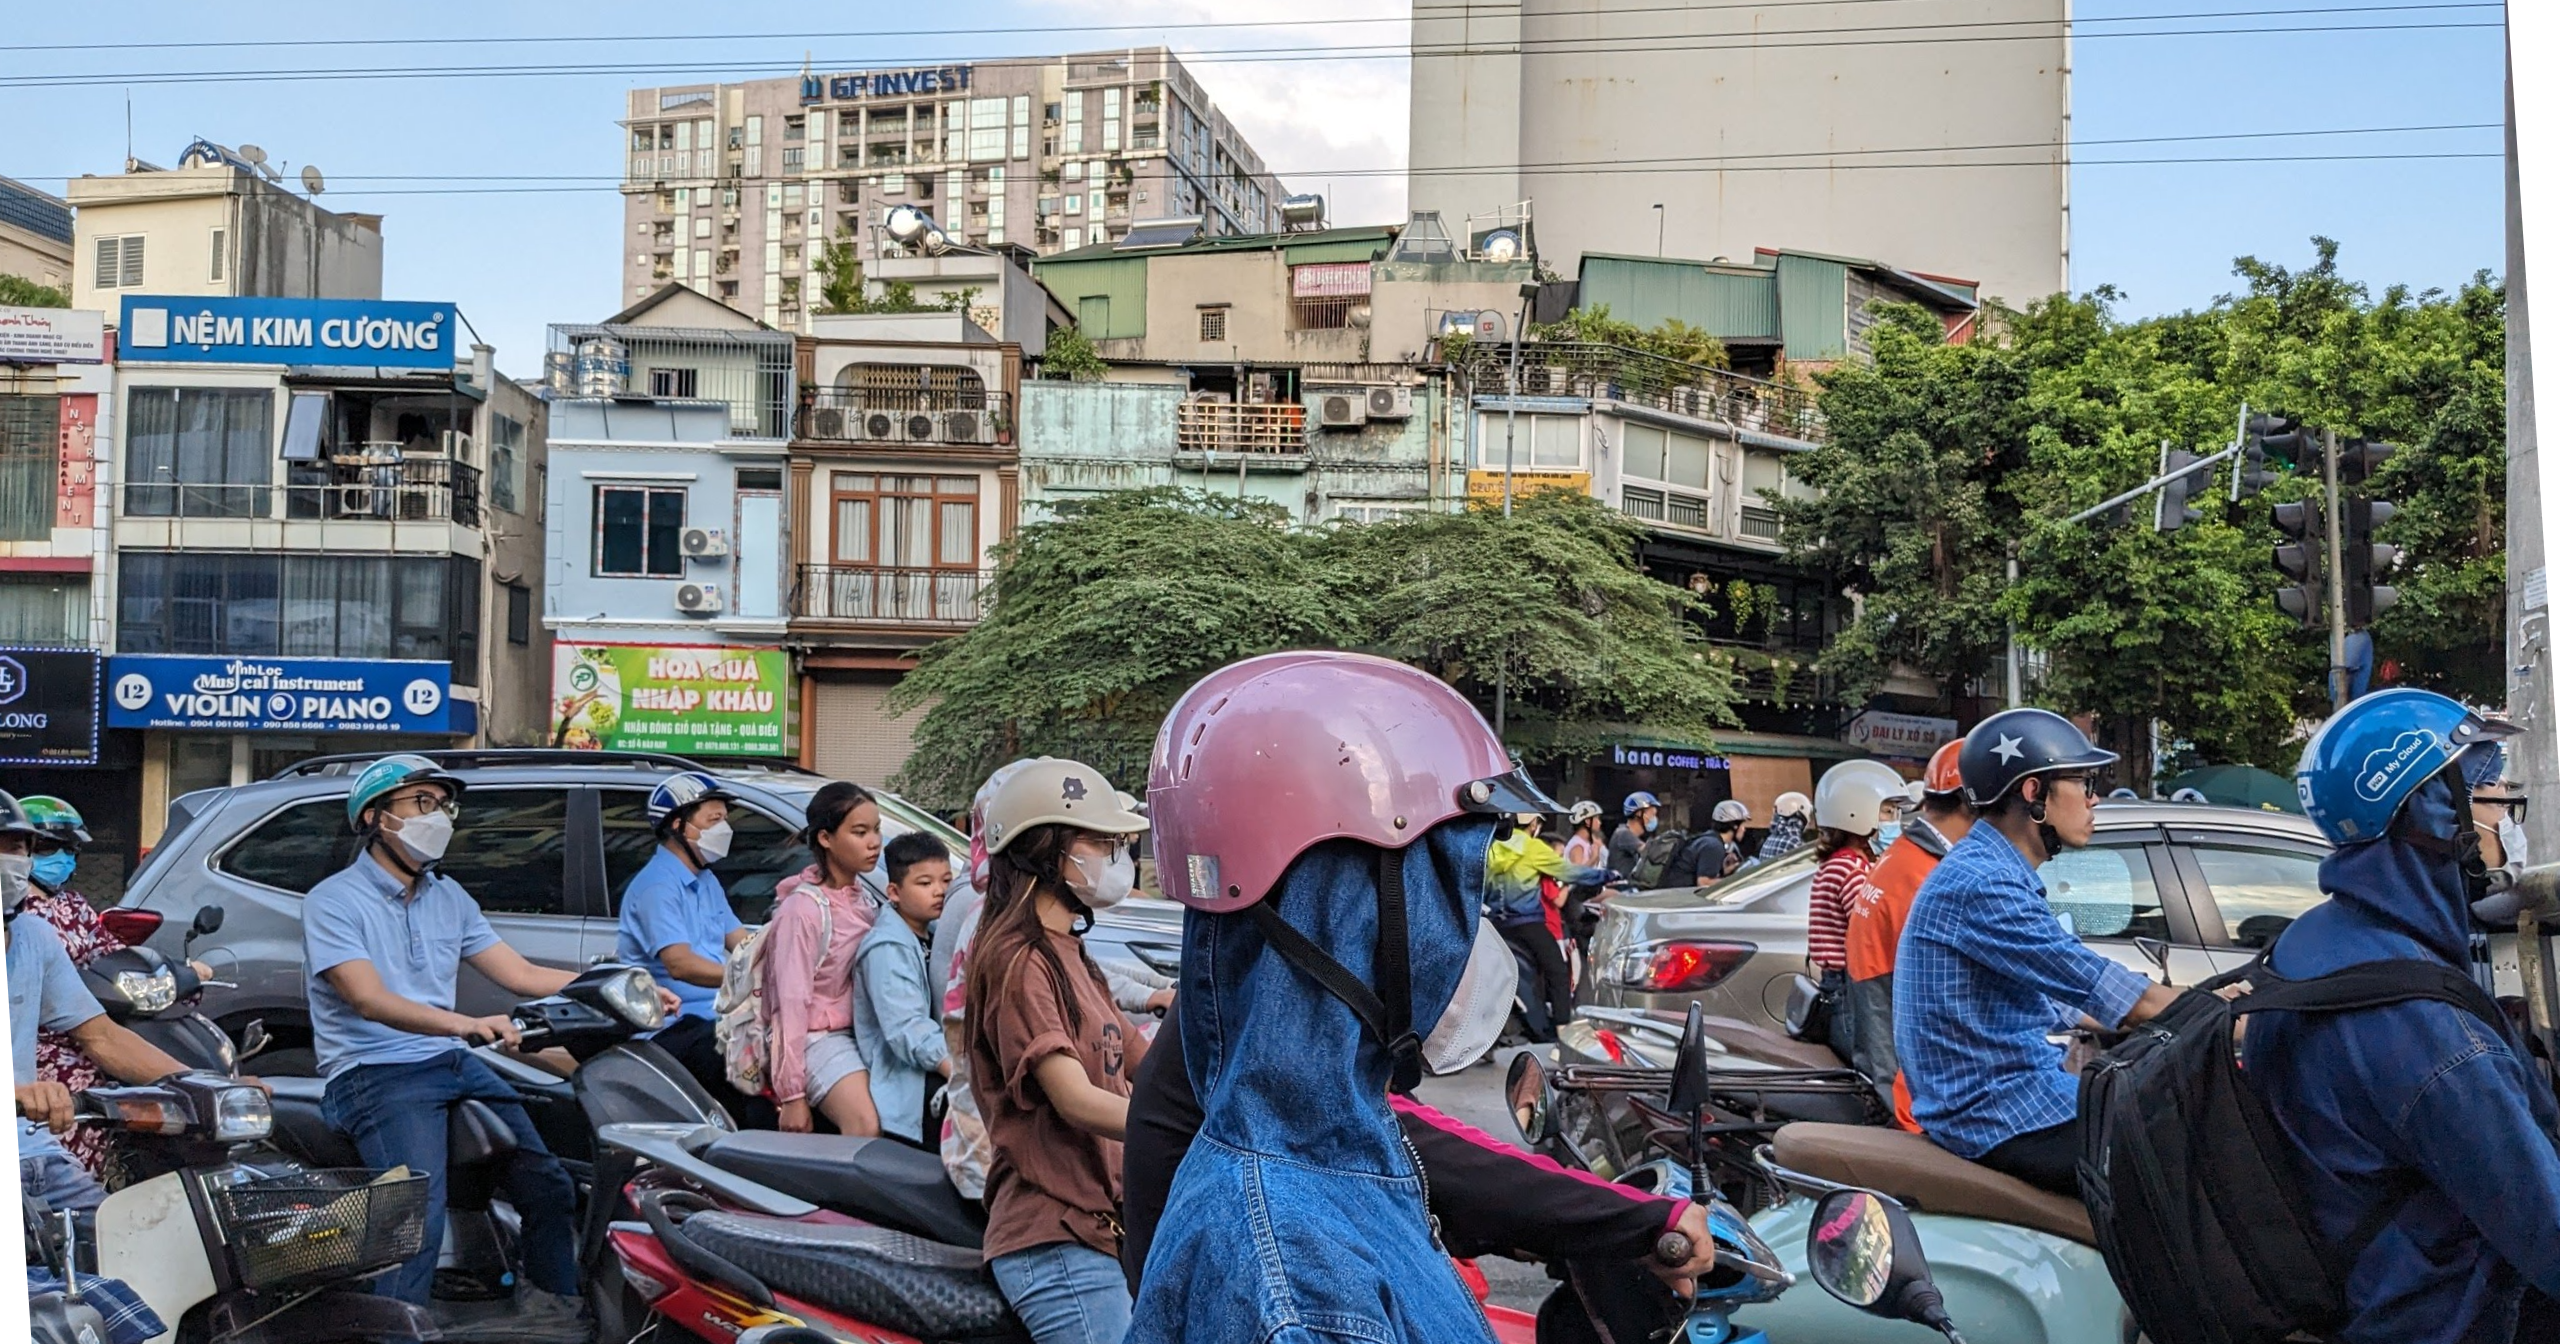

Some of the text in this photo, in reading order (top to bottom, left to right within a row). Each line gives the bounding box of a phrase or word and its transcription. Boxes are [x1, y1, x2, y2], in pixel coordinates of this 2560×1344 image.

[174, 310, 244, 351] NỆM
[253, 318, 313, 347] KIM
[648, 656, 702, 681] HOA
[122, 684, 145, 699] 12
[272, 676, 364, 692] instrument
[166, 694, 392, 720] VIOLIN PIANO
[412, 689, 434, 705] 12
[632, 685, 701, 715] NHẬP
[150, 719, 186, 728] Hotline:
[624, 721, 648, 736] NHẬN
[691, 721, 708, 736] QUÀ
[709, 721, 732, 738] TẶNG
[739, 722, 757, 737] QUÀ
[1614, 744, 1664, 767] hana
[1667, 754, 1699, 769] COFFEE
[2384, 759, 2401, 774] My
[2397, 736, 2423, 761] Cloud
